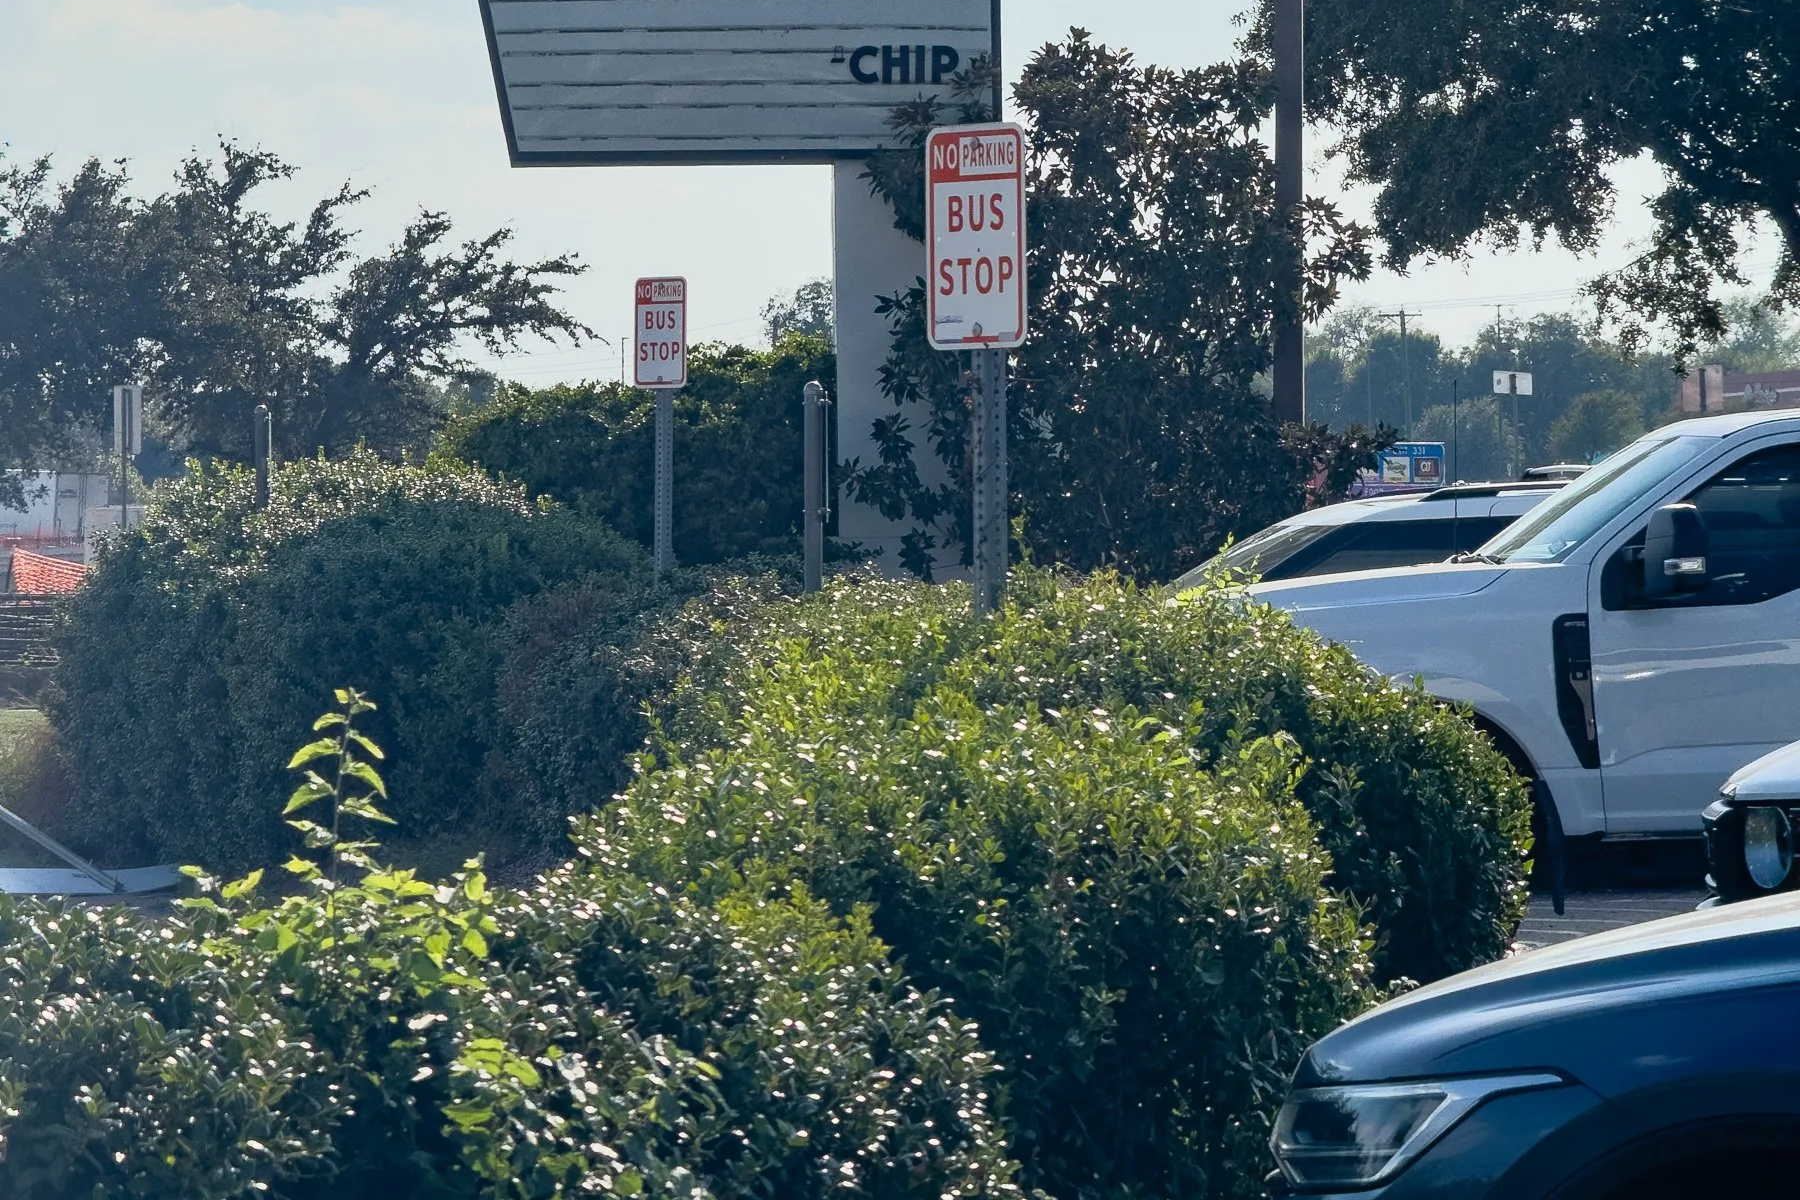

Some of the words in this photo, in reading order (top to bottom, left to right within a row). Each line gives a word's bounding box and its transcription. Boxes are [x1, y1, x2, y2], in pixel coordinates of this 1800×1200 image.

[933, 143, 958, 170] NO
[962, 141, 1014, 168] PARKING
[948, 193, 1005, 233] BUS
[939, 256, 1014, 296] STOP
[637, 285, 651, 299] NO
[653, 284, 682, 298] PARKING
[645, 310, 676, 330] BUS
[640, 341, 680, 362] STOP
[1412, 446, 1426, 455] 331
